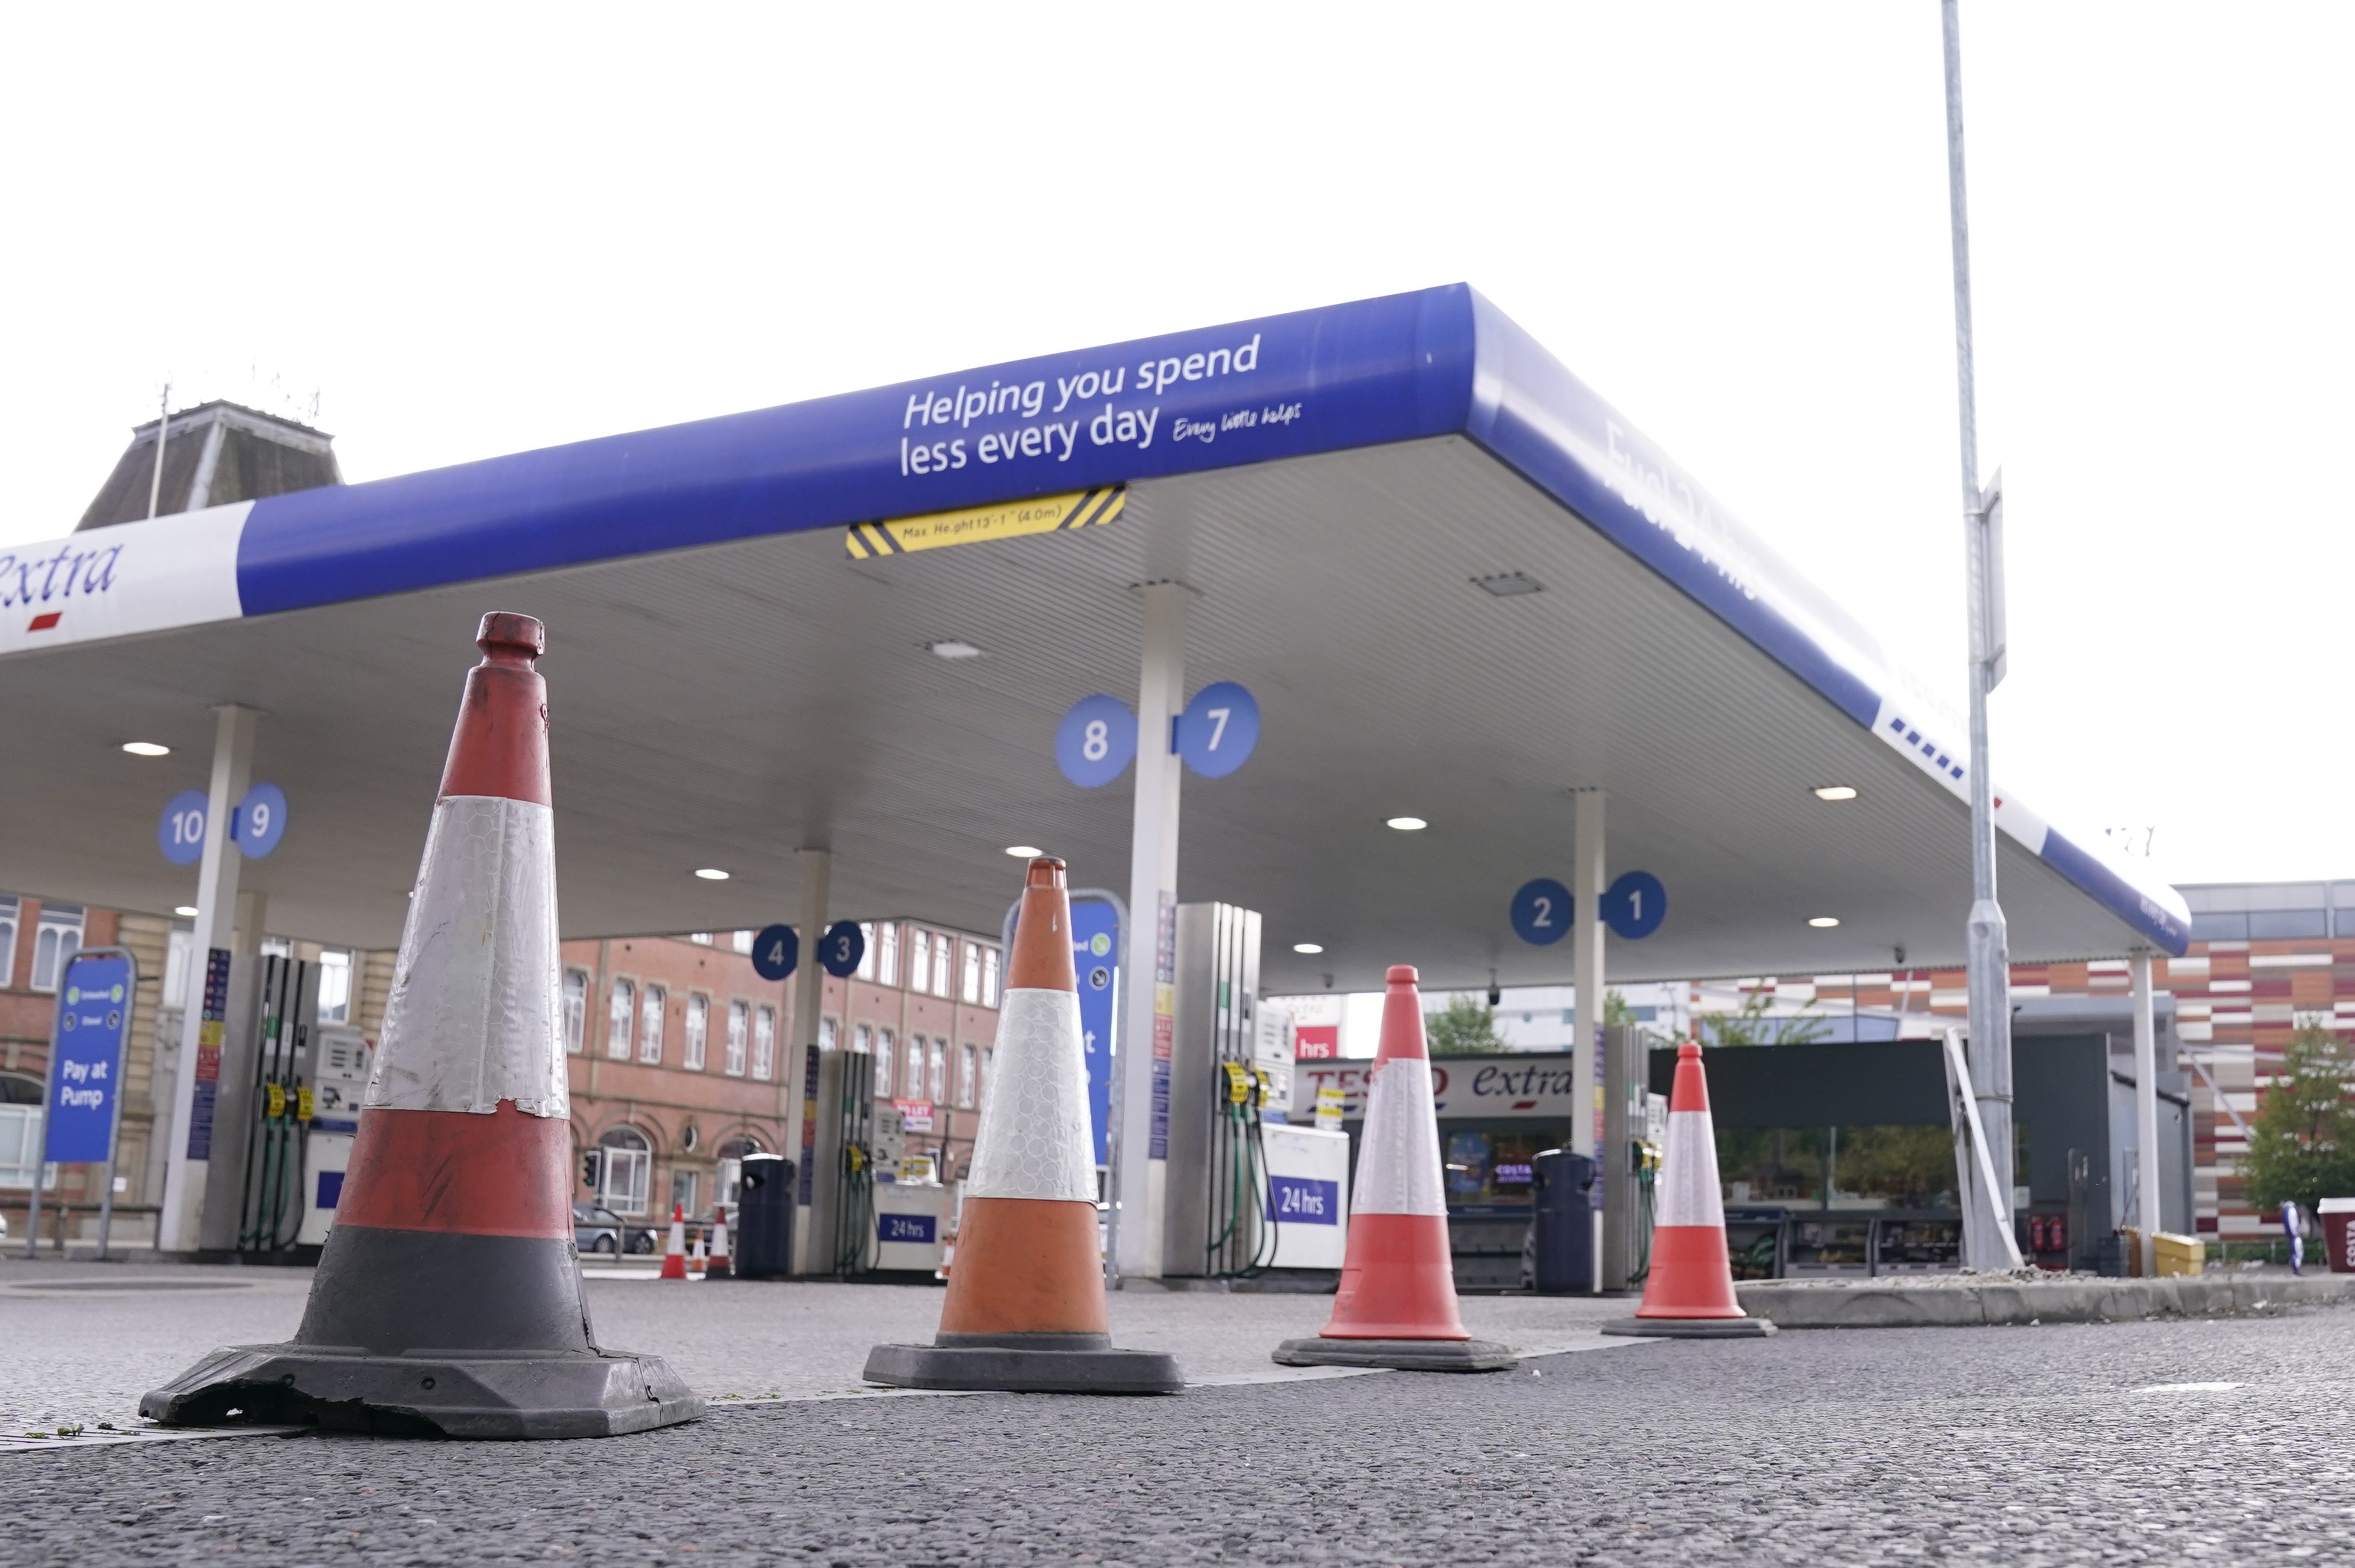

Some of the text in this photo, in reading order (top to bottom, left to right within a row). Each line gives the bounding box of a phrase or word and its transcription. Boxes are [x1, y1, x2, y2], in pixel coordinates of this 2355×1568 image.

[903, 333, 1261, 429] Helping you spend
[901, 402, 1159, 476] less every day
[1172, 402, 1302, 444] Every little helps
[1083, 720, 1109, 762] 8
[1207, 708, 1230, 751] 7
[172, 809, 204, 845] 10
[252, 803, 270, 837] 9
[1533, 896, 1551, 927] 2
[1628, 890, 1641, 920] 1
[768, 939, 784, 966] 4
[836, 936, 850, 962] 3
[62, 1059, 108, 1085] Pay at
[1307, 1065, 1572, 1098] TESO extra
[60, 1086, 103, 1111] Pump
[911, 1105, 929, 1117] LET
